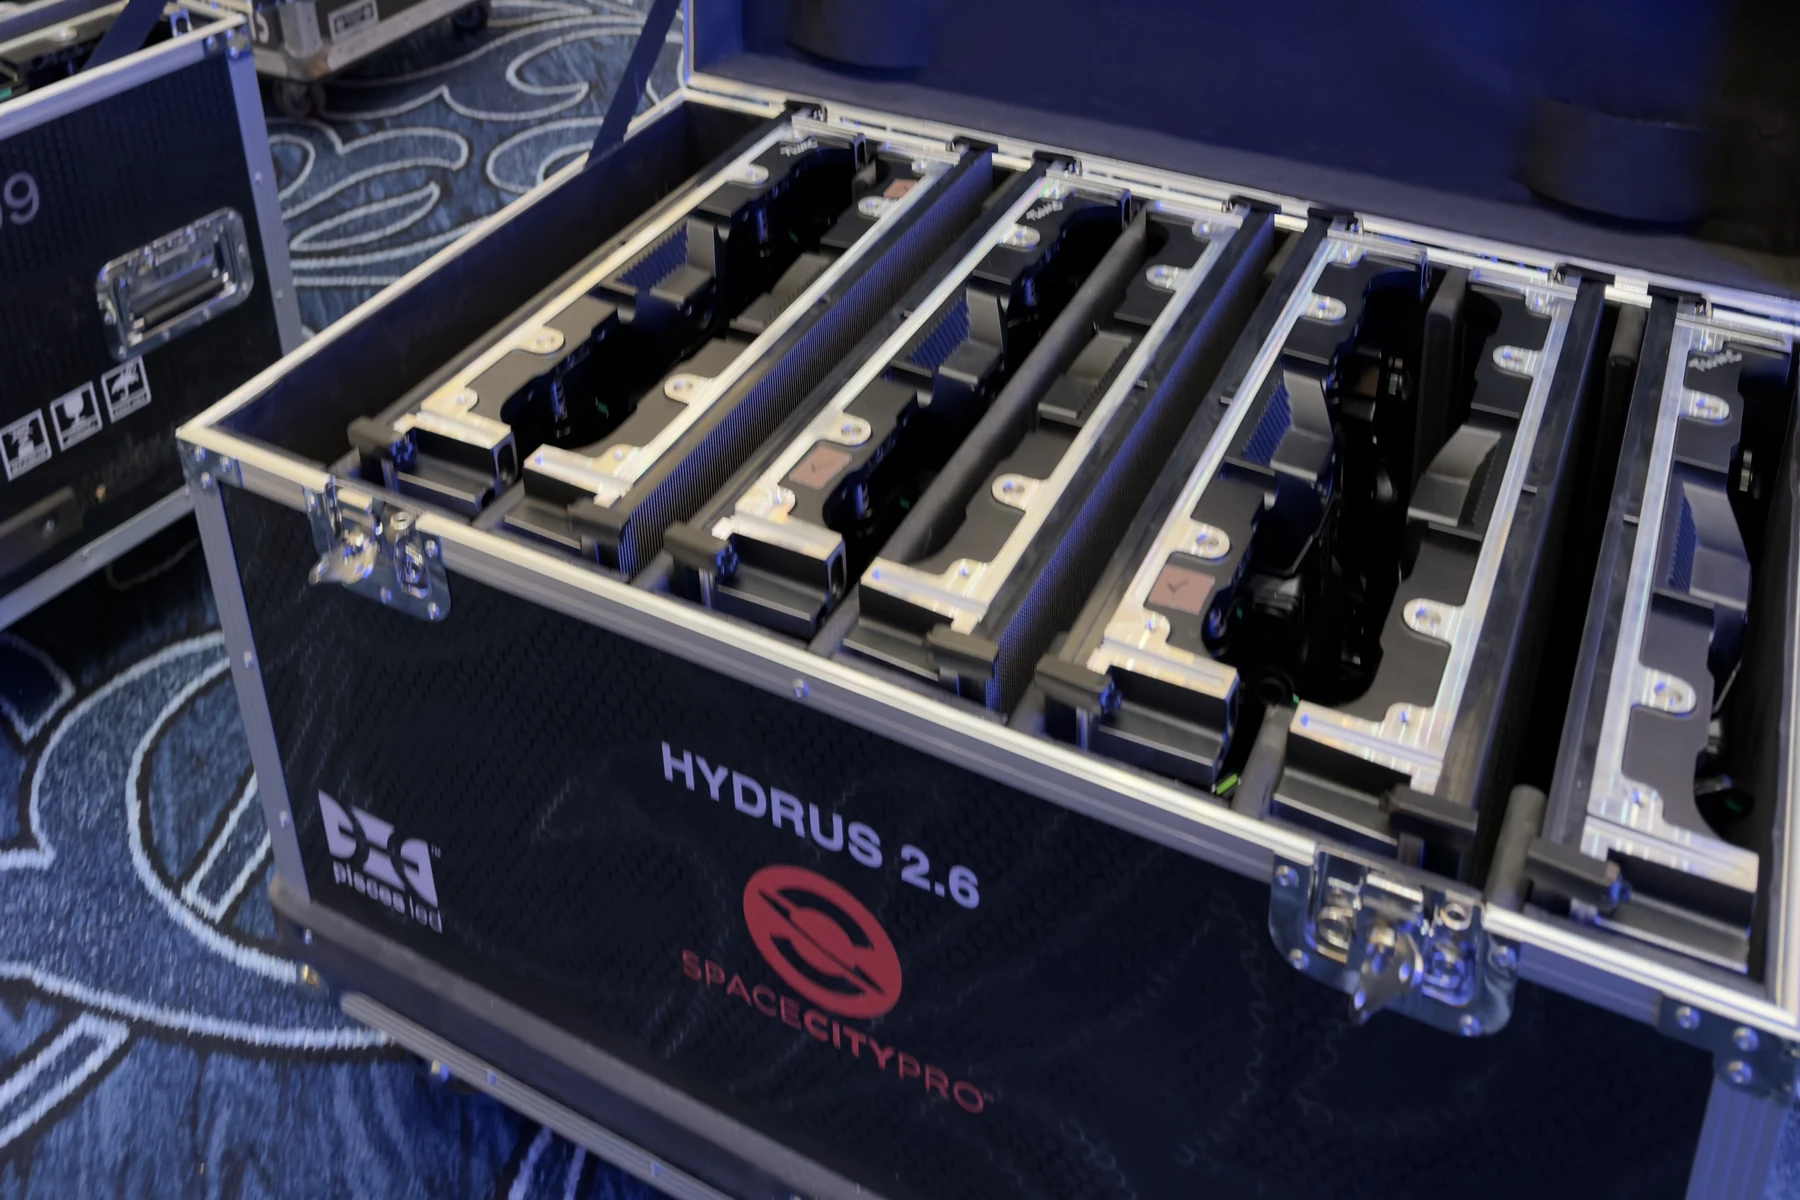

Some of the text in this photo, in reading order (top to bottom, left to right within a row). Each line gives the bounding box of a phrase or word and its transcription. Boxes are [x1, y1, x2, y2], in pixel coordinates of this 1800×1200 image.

[0, 171, 40, 230] 9
[661, 740, 980, 909] HYDRUS 2.6
